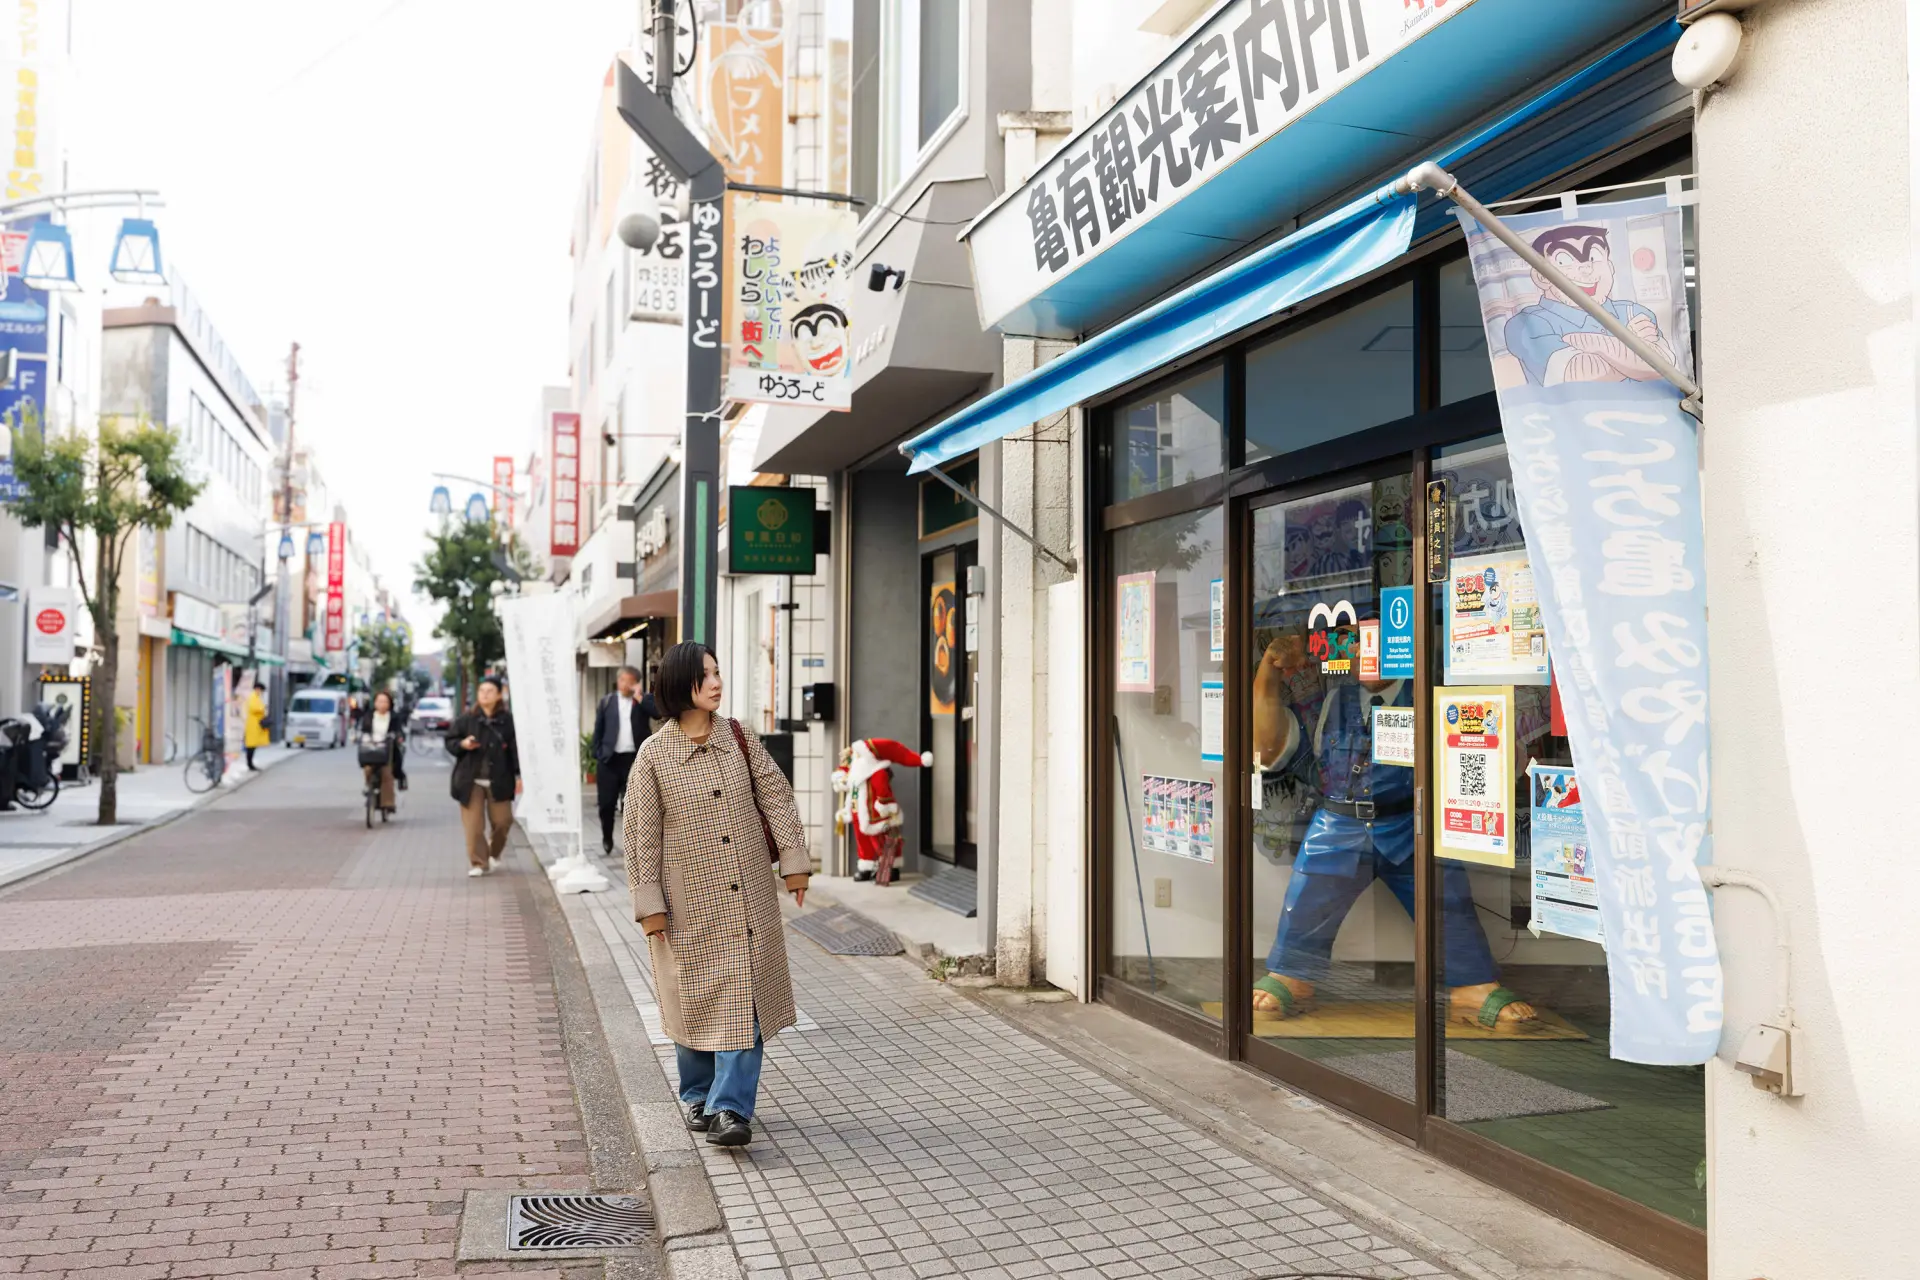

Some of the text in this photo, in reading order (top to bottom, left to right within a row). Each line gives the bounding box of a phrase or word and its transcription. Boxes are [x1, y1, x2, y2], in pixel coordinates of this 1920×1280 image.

[1400, 5, 1434, 37] Kameari
[1027, 0, 1369, 273] 亀有観光案内所
[692, 202, 721, 349] ゆうろーど
[759, 373, 825, 402] ゆうろーど
[1455, 572, 1486, 594] こち亀
[1309, 630, 1356, 661] ゆうろーど
[1459, 703, 1485, 719] こち亀
